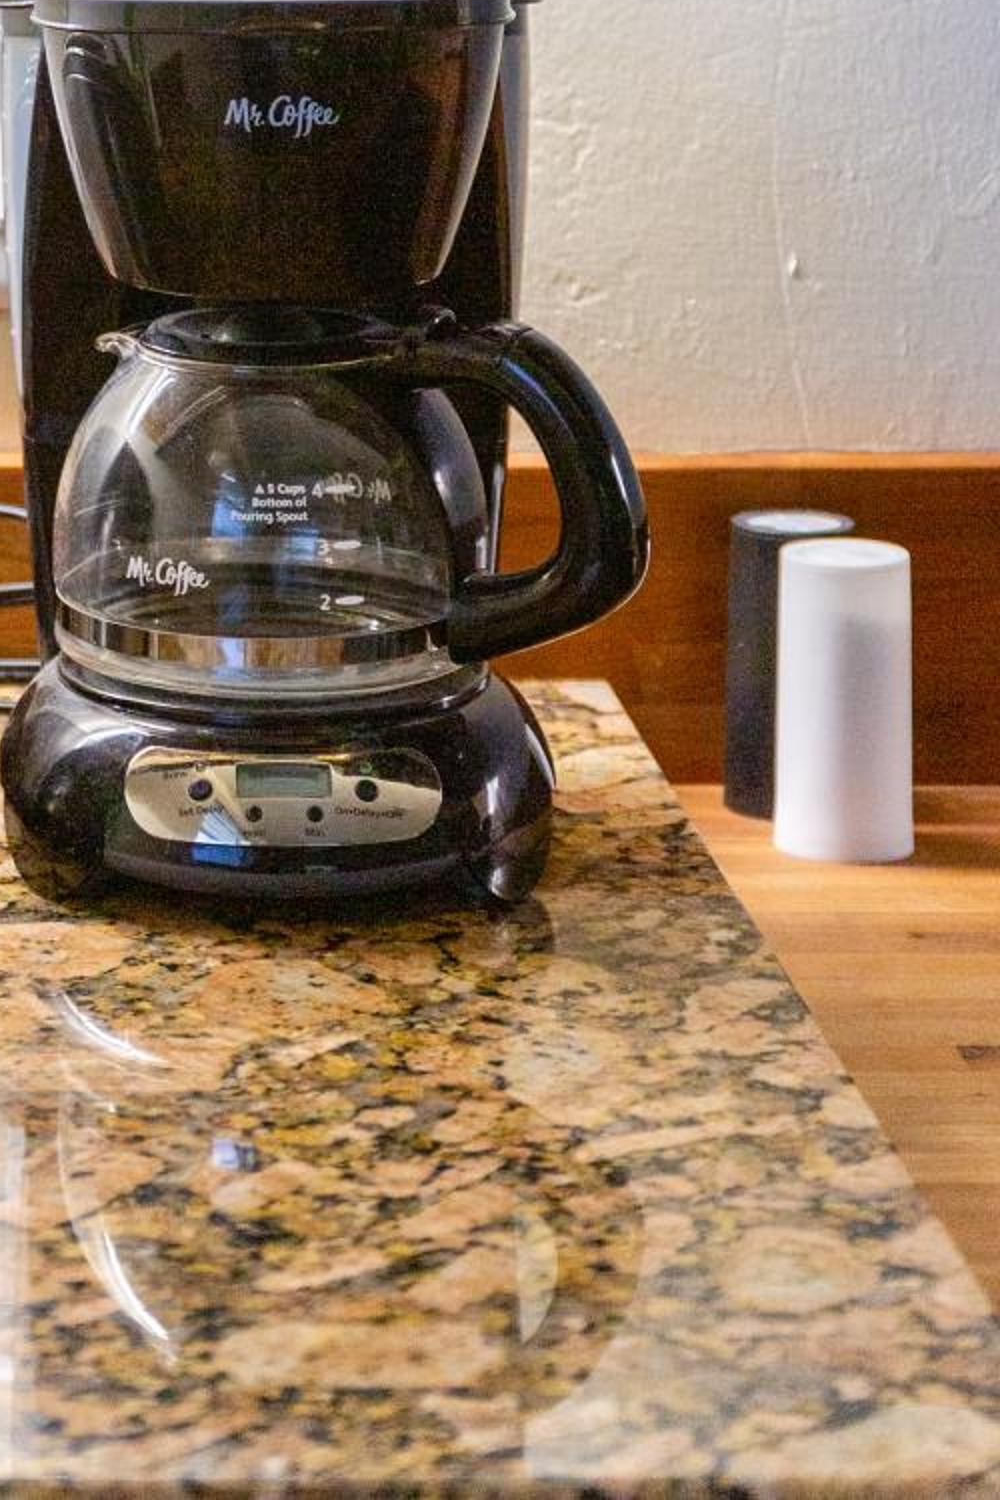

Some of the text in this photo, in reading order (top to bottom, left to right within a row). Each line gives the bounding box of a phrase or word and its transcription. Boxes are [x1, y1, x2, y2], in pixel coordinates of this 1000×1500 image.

[223, 94, 340, 139] Mr. Coffee
[277, 483, 306, 497] Cups
[251, 496, 293, 508] Bottom
[275, 510, 309, 524] Spout
[155, 557, 211, 597] Coffee
[319, 593, 332, 611] 2
